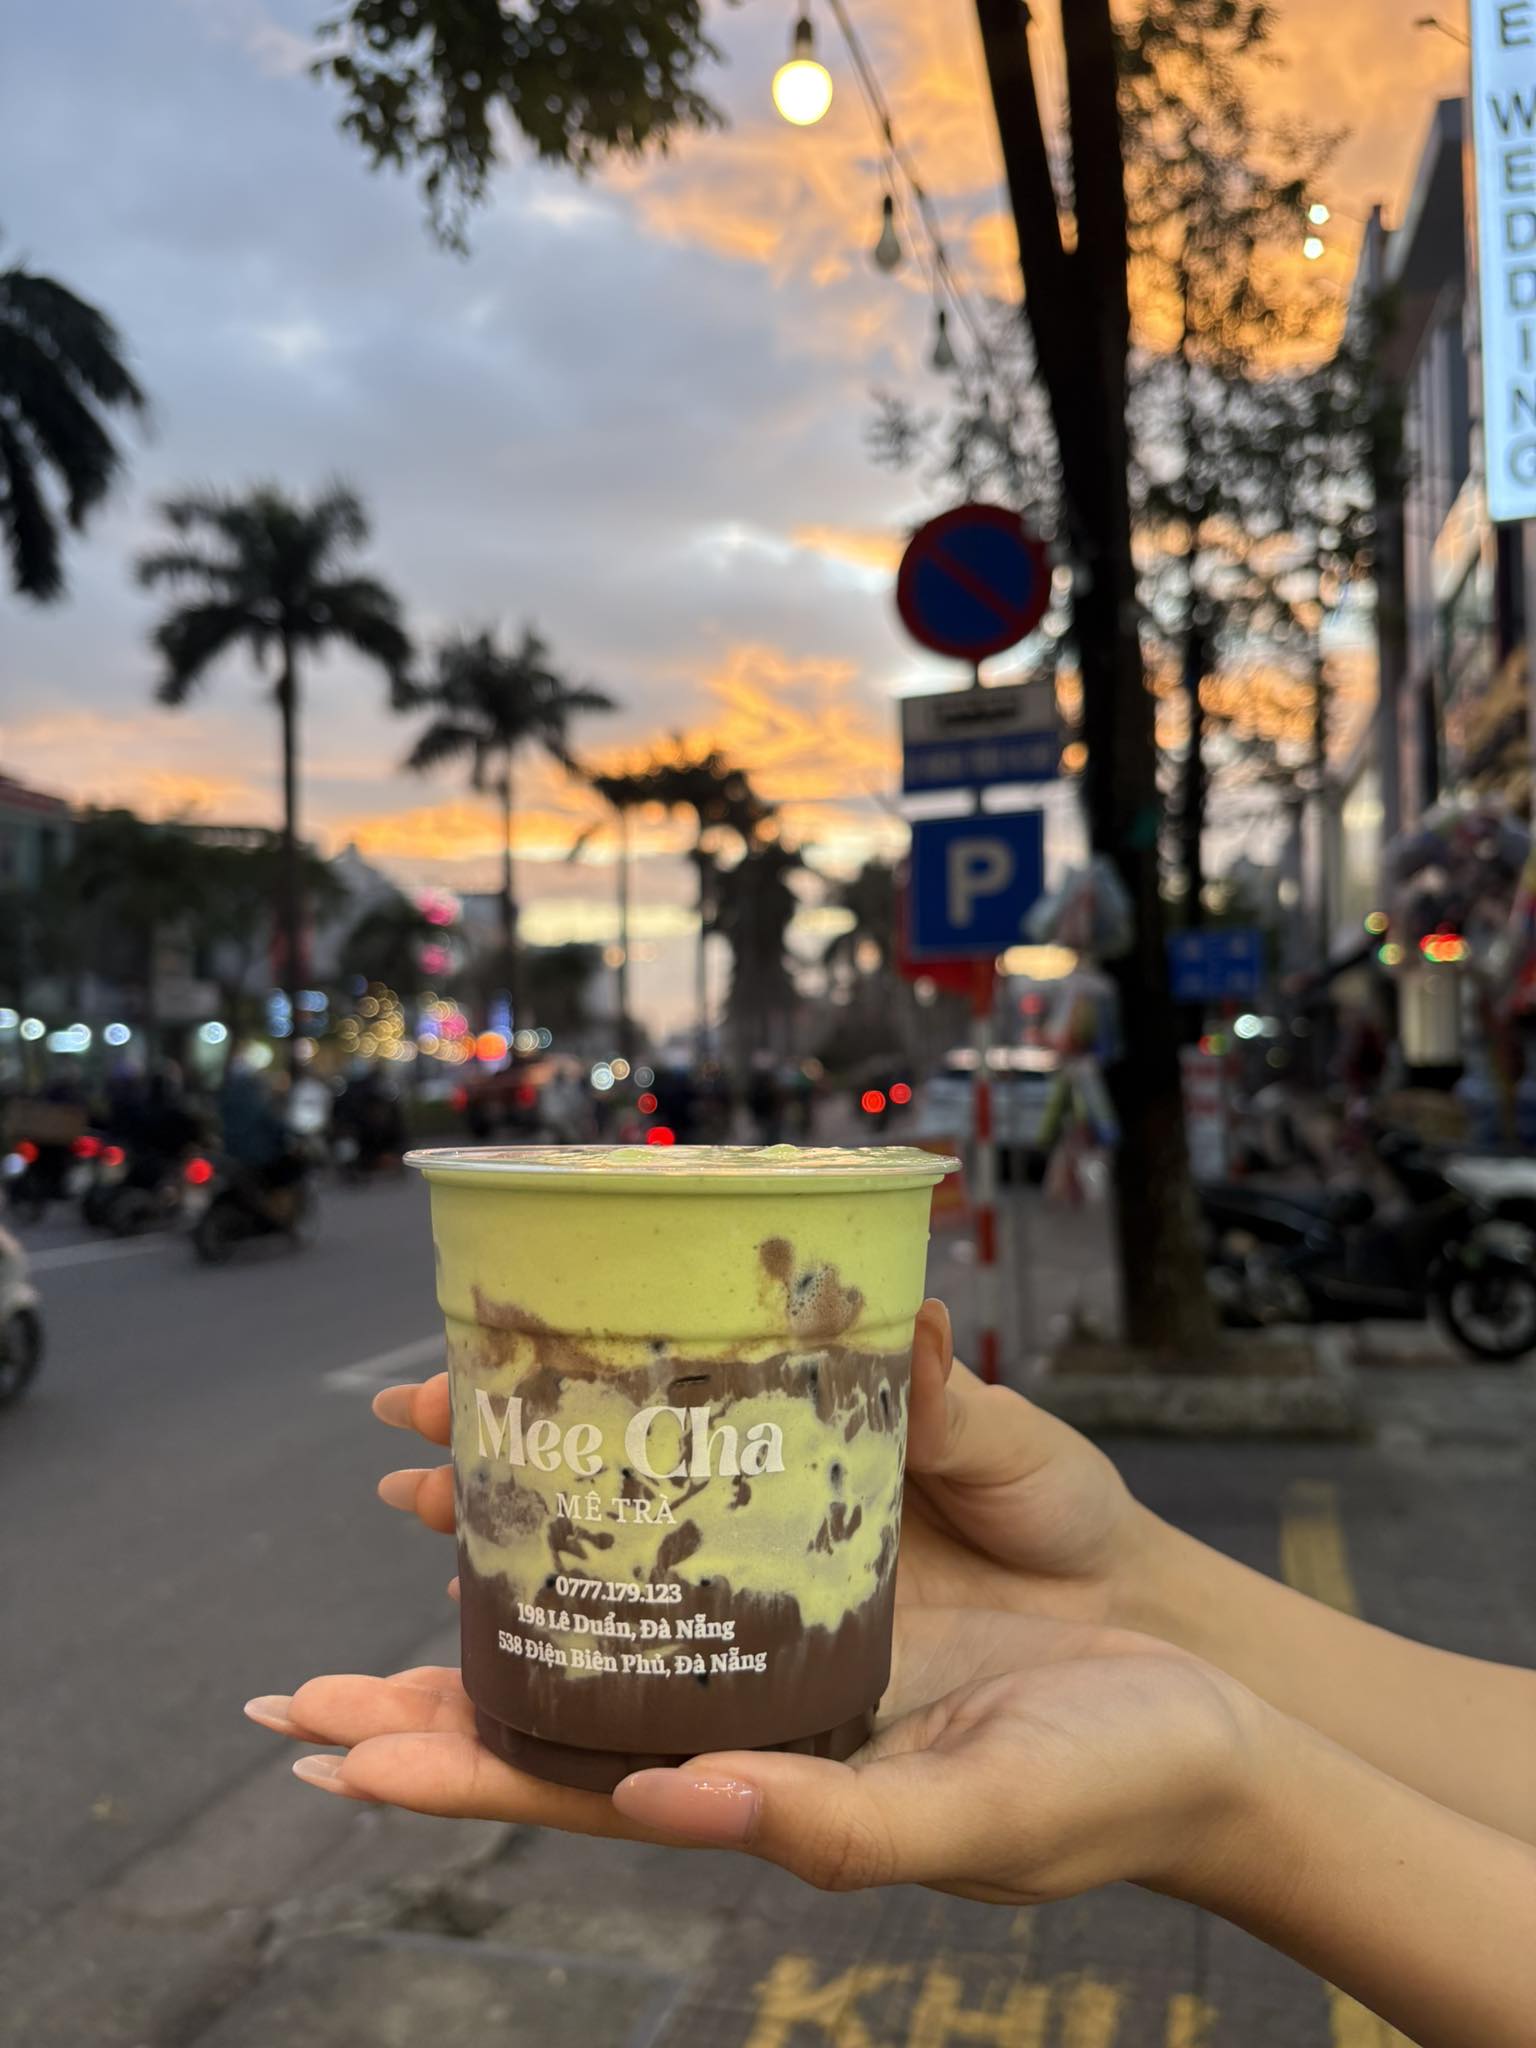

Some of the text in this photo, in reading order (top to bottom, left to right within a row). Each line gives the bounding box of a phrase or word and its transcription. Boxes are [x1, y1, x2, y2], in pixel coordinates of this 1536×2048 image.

[1490, 87, 1536, 486] WEDDING
[946, 837, 1014, 929] P
[475, 1388, 785, 1480] Mee Cha
[556, 1491, 677, 1525] MÊ TRÀ
[555, 1575, 682, 1604] 0777.179.123
[517, 1602, 736, 1641] 198 Lê Duẩn, Đà Nẵng
[498, 1630, 767, 1678] 538 Điện Biên Phủ, Đà Nẵng
